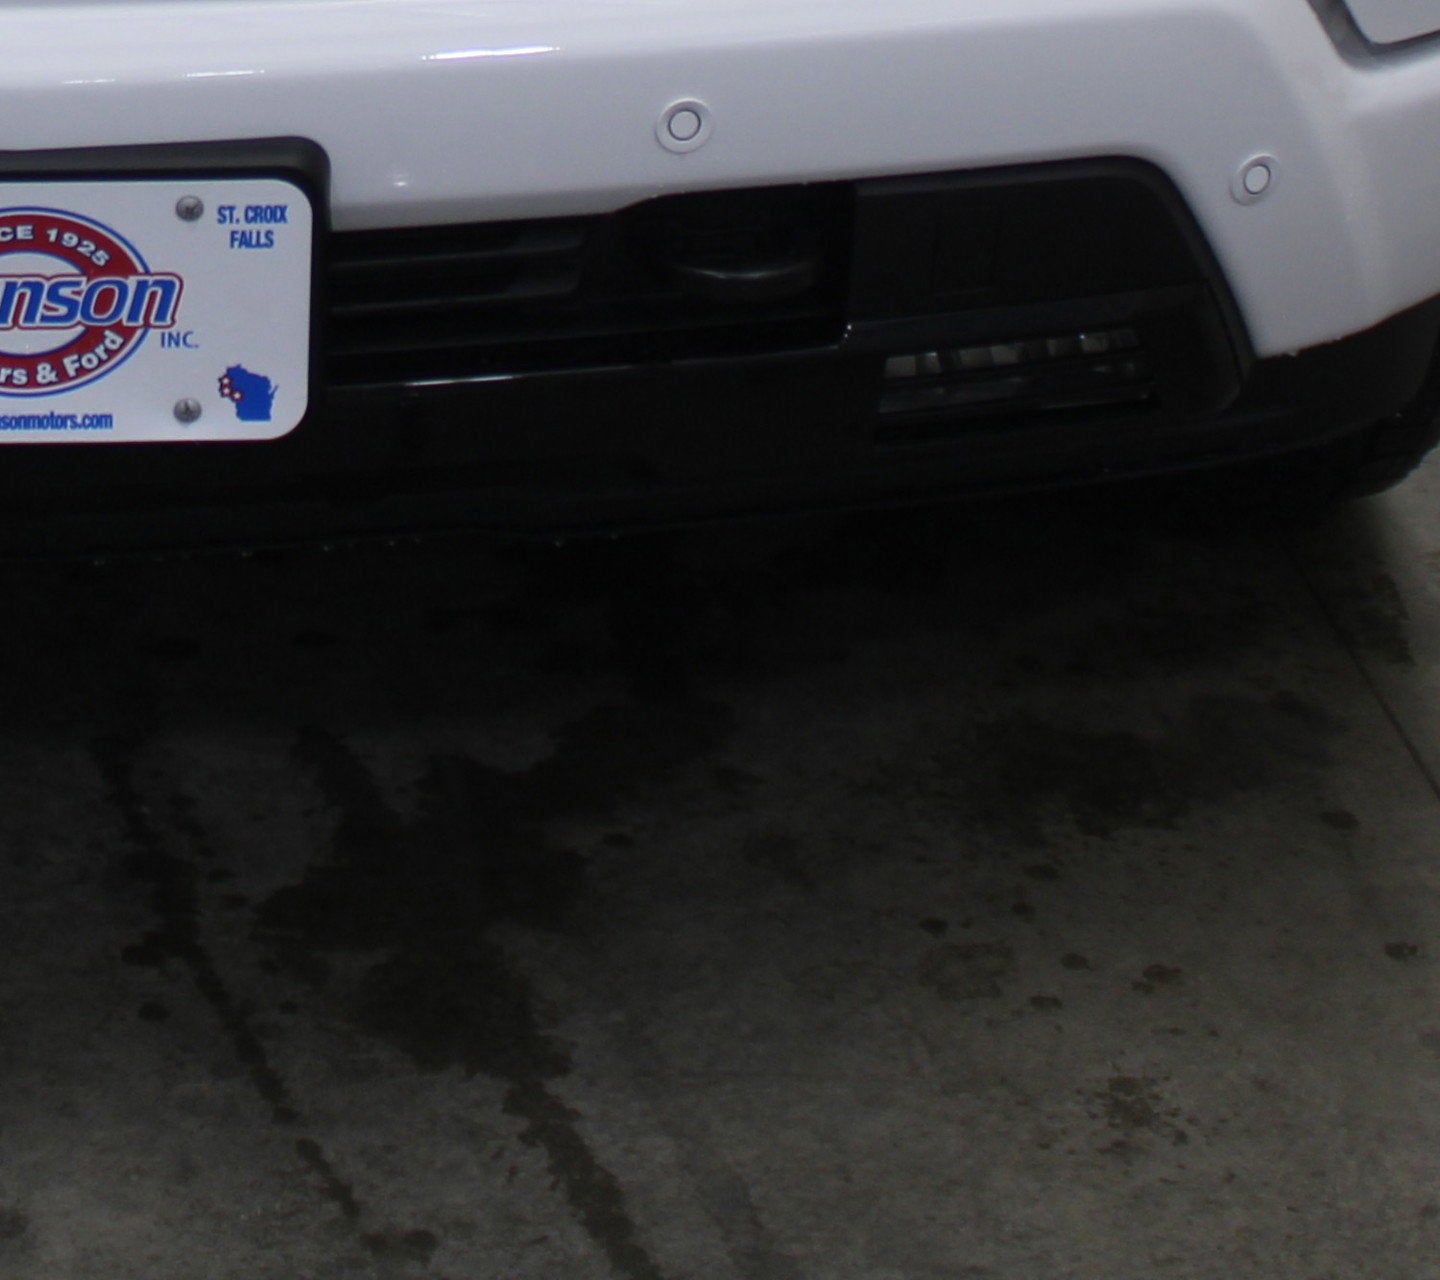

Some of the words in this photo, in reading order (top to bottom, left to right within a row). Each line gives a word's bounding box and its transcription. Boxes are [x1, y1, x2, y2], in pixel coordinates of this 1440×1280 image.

[217, 205, 240, 224] ST.
[244, 205, 288, 224] CROIX
[46, 227, 111, 267] 1925
[229, 229, 274, 249] FALLS
[160, 331, 199, 349] INC.
[36, 362, 58, 385] &
[62, 329, 125, 378] Ford
